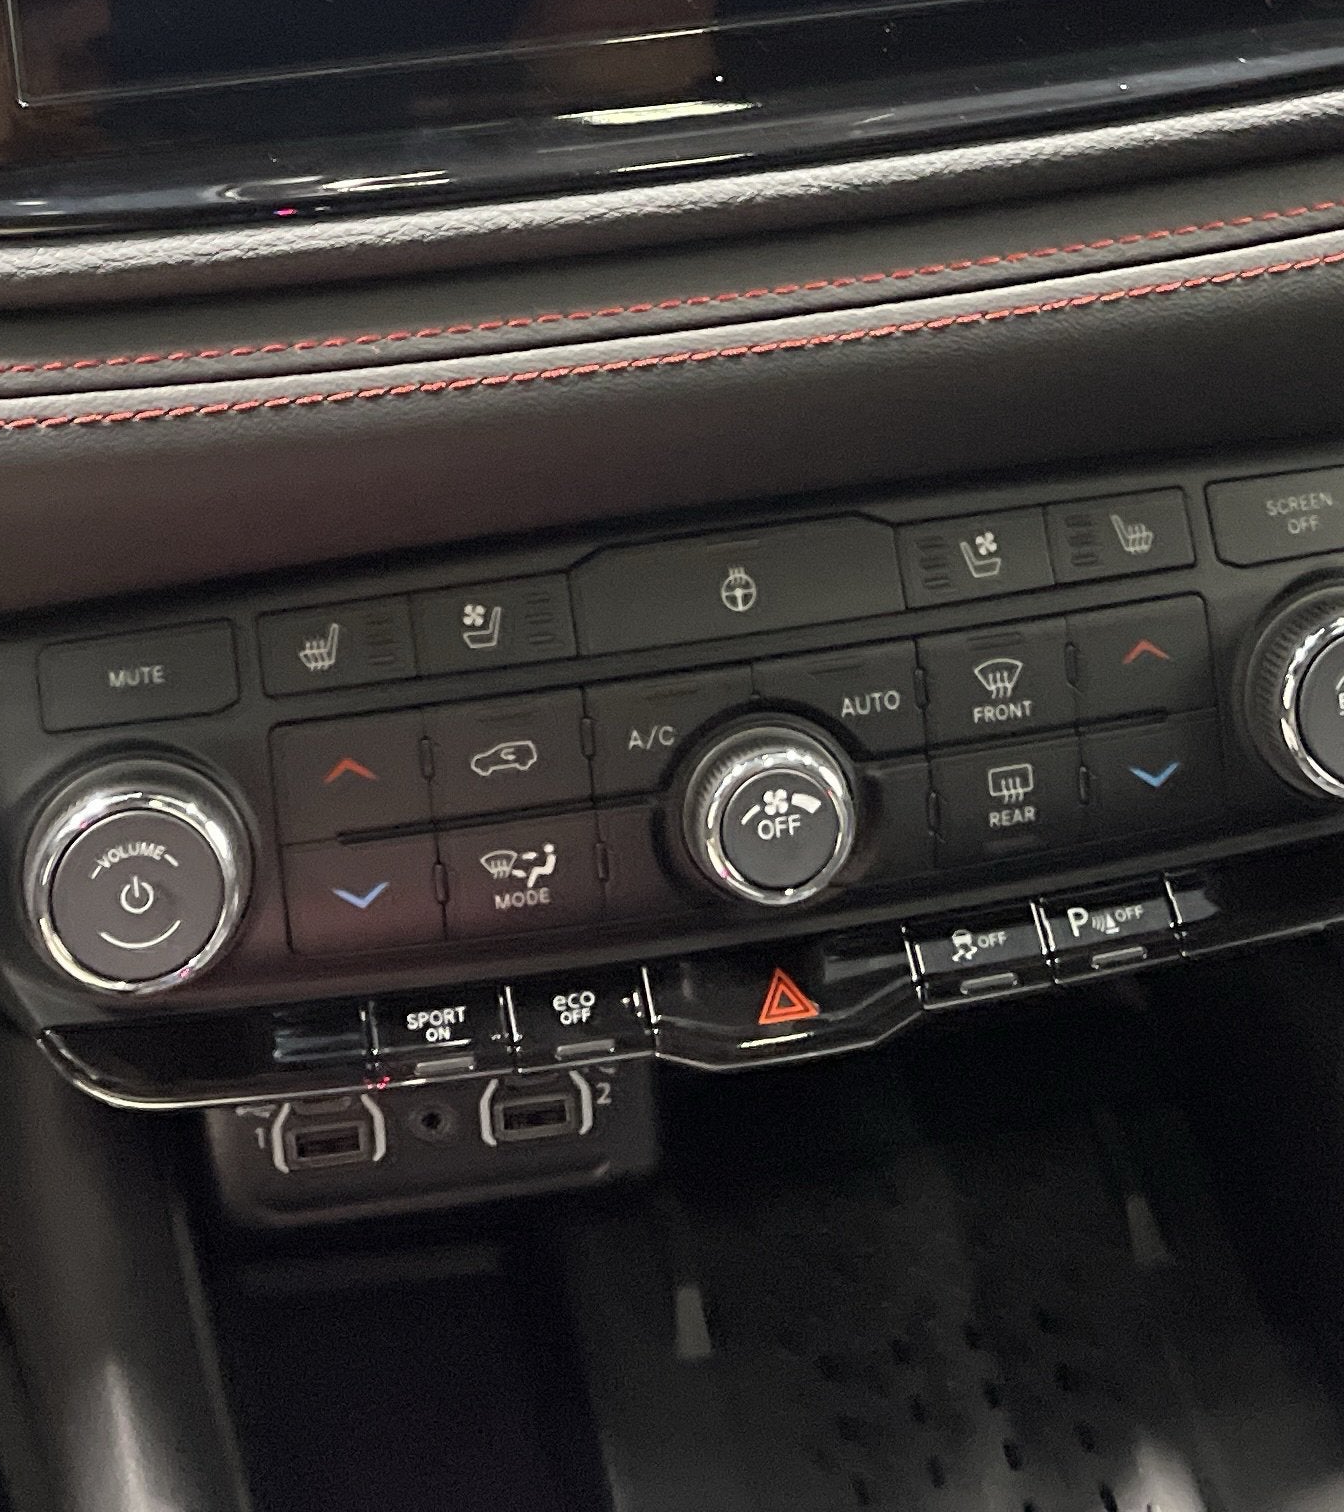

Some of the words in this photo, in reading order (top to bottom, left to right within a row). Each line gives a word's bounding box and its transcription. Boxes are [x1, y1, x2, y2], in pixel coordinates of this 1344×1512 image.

[1265, 491, 1334, 516] SCREEN
[1286, 514, 1322, 535] OFF
[108, 665, 165, 689] MUTE
[840, 690, 901, 718] AUTO
[972, 700, 1033, 724] FRONT
[627, 724, 677, 752] A/C
[757, 814, 802, 840] OFF
[988, 805, 1037, 828] REAR
[98, 842, 166, 869] VOLUME
[494, 888, 552, 911] MODE
[1067, 906, 1089, 937] P
[1115, 904, 1144, 925] OFF
[977, 931, 1008, 951] OFF
[406, 1005, 467, 1032] SPORT
[560, 1008, 592, 1026] OFF
[425, 1026, 451, 1043] ON
[596, 1082, 612, 1105] 2
